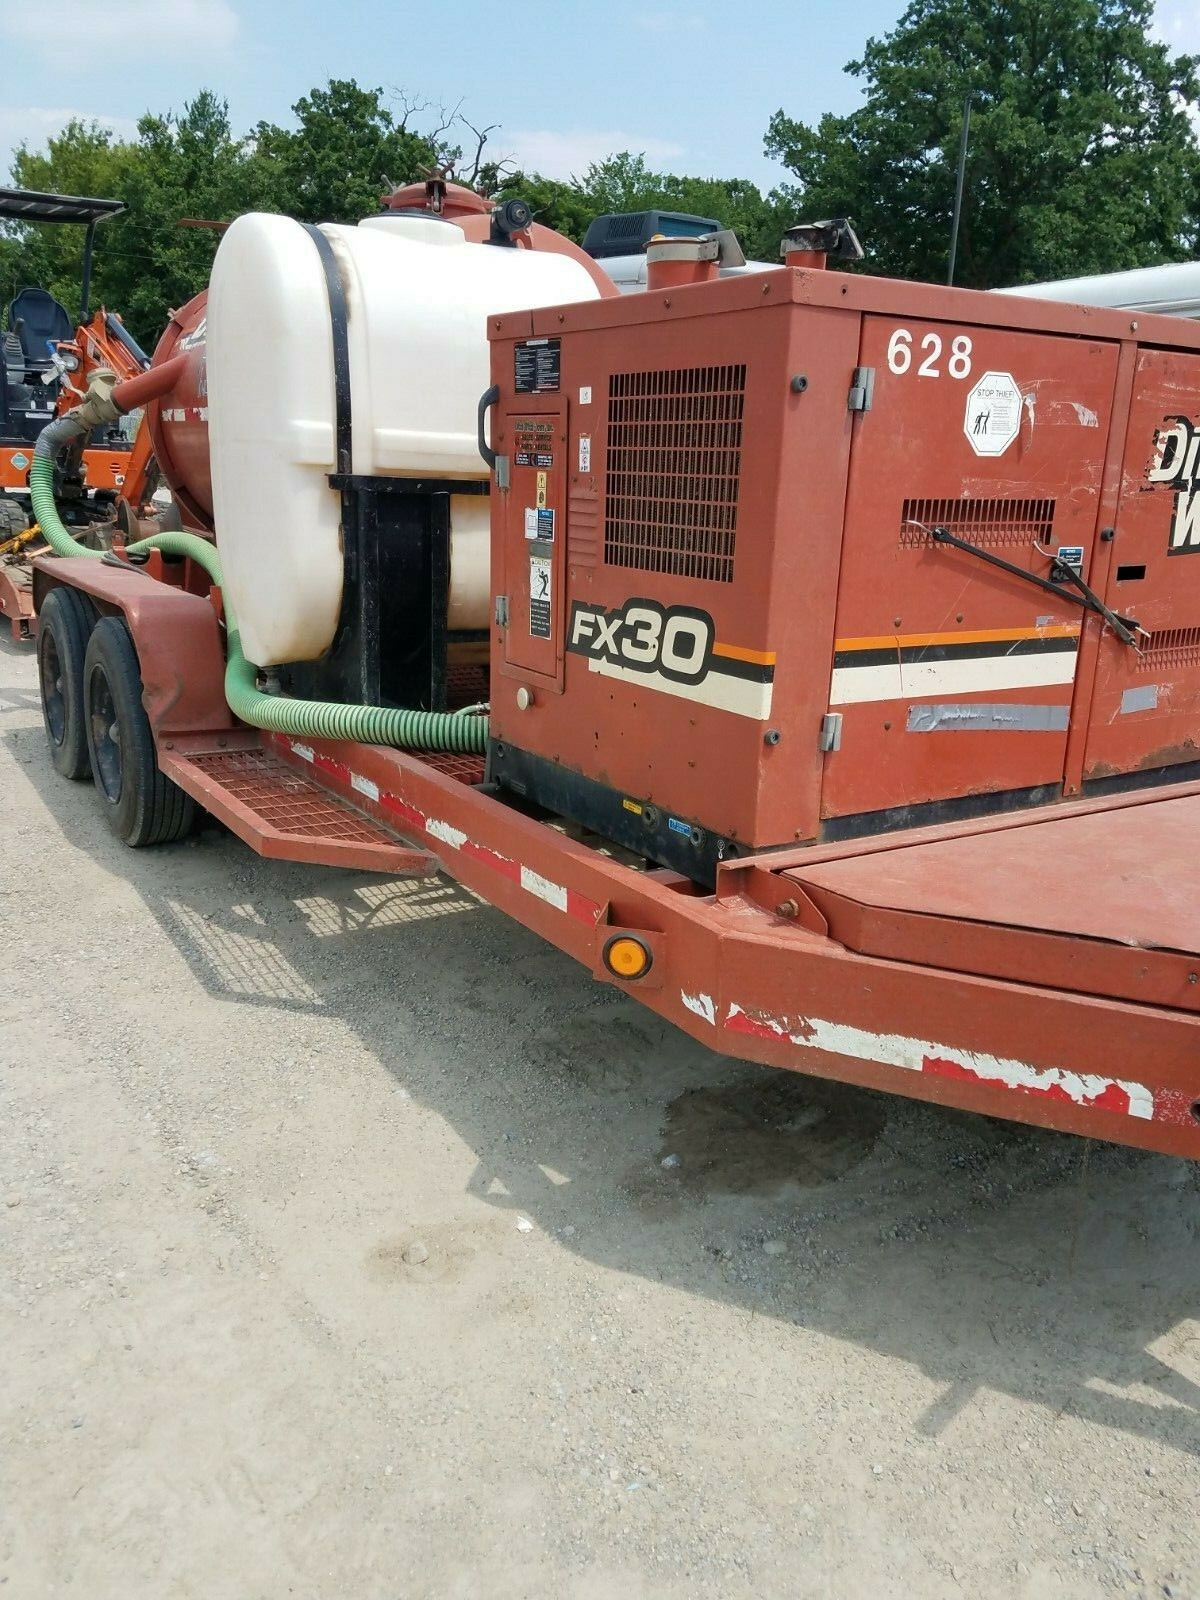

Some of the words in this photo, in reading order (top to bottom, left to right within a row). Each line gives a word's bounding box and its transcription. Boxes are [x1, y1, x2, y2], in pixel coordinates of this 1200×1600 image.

[887, 328, 973, 379] 628
[977, 389, 995, 397] STOP
[1147, 422, 1200, 482] Di
[571, 607, 709, 675] FX30
